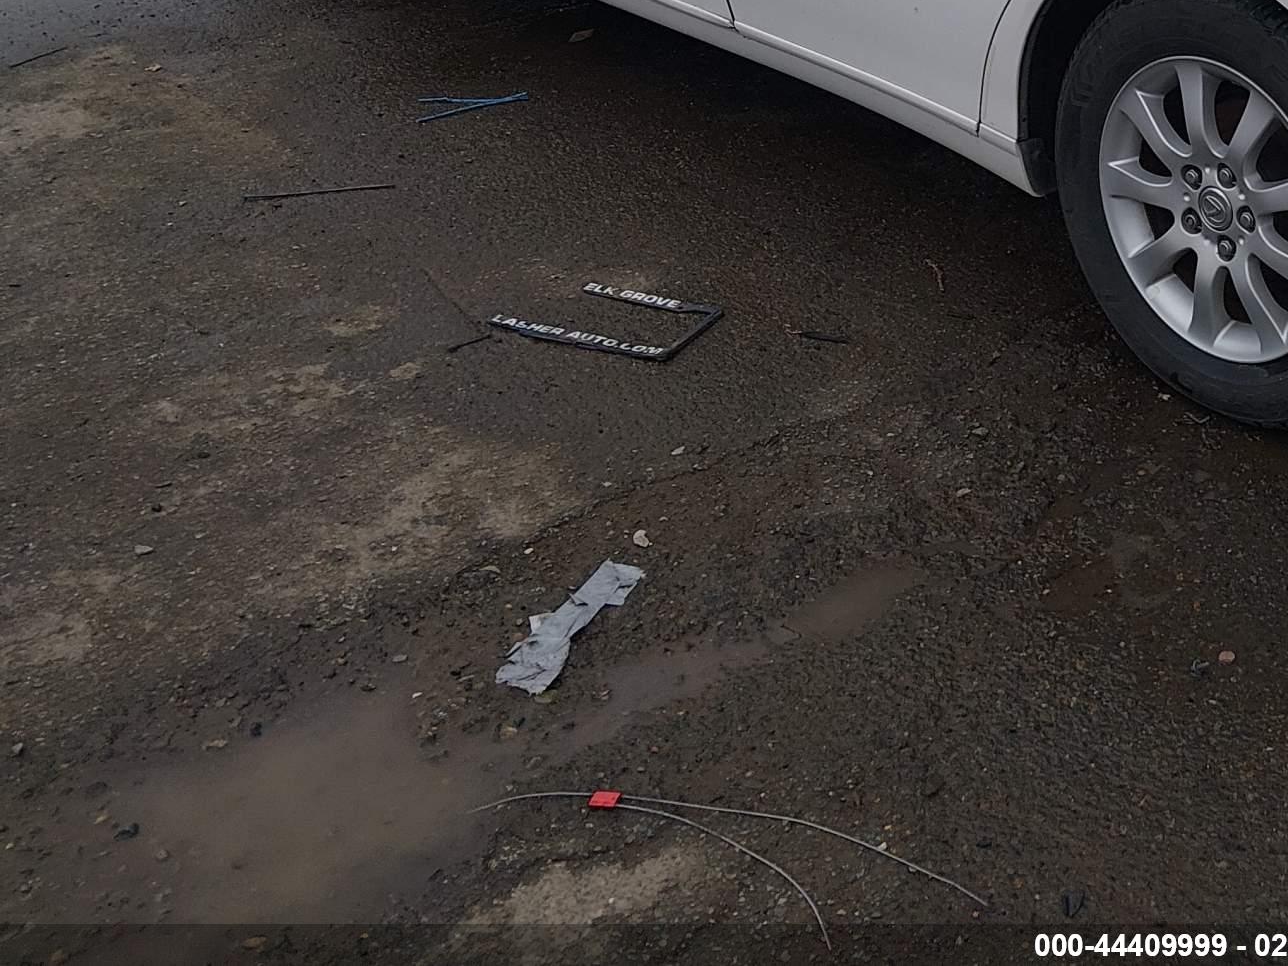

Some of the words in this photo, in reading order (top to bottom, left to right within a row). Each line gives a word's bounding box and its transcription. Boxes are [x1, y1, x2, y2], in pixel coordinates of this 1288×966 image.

[583, 282, 616, 296] ELK
[619, 289, 682, 309] GROVE
[491, 314, 565, 336] LASHER
